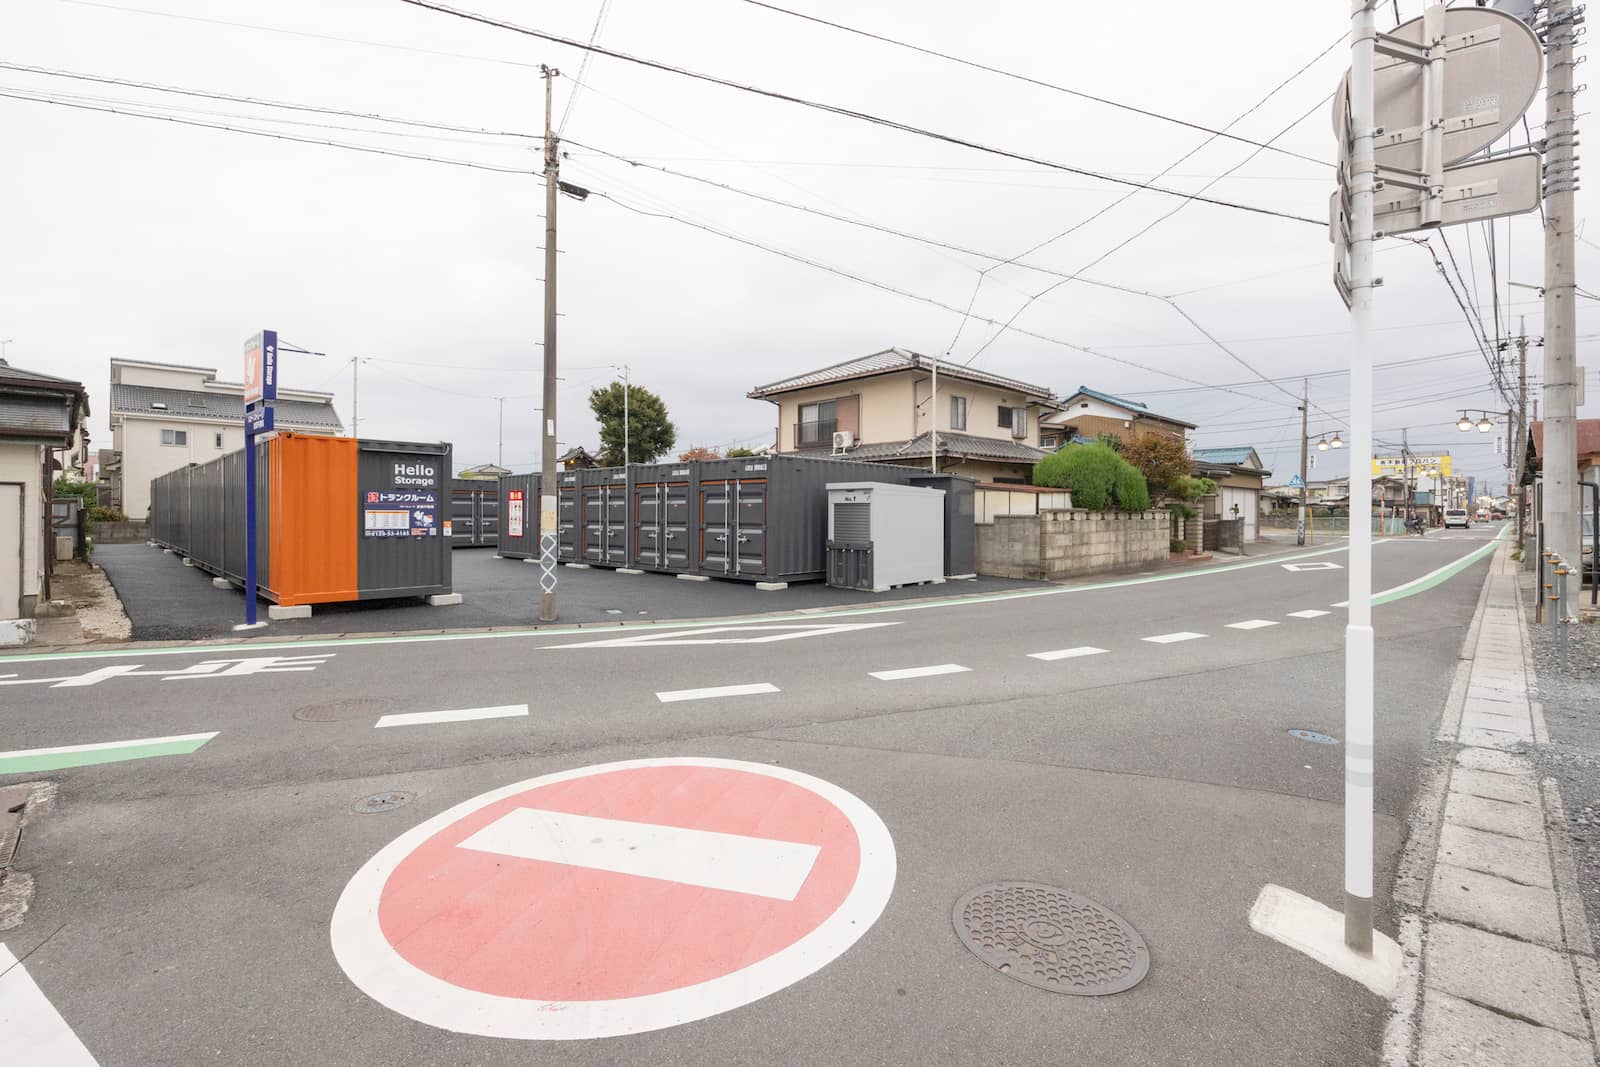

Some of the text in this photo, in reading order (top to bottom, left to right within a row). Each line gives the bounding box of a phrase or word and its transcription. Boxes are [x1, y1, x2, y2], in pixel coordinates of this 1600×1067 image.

[394, 463, 434, 476] Hello
[394, 476, 434, 487] Storage
[380, 493, 434, 502] トランクルーム
